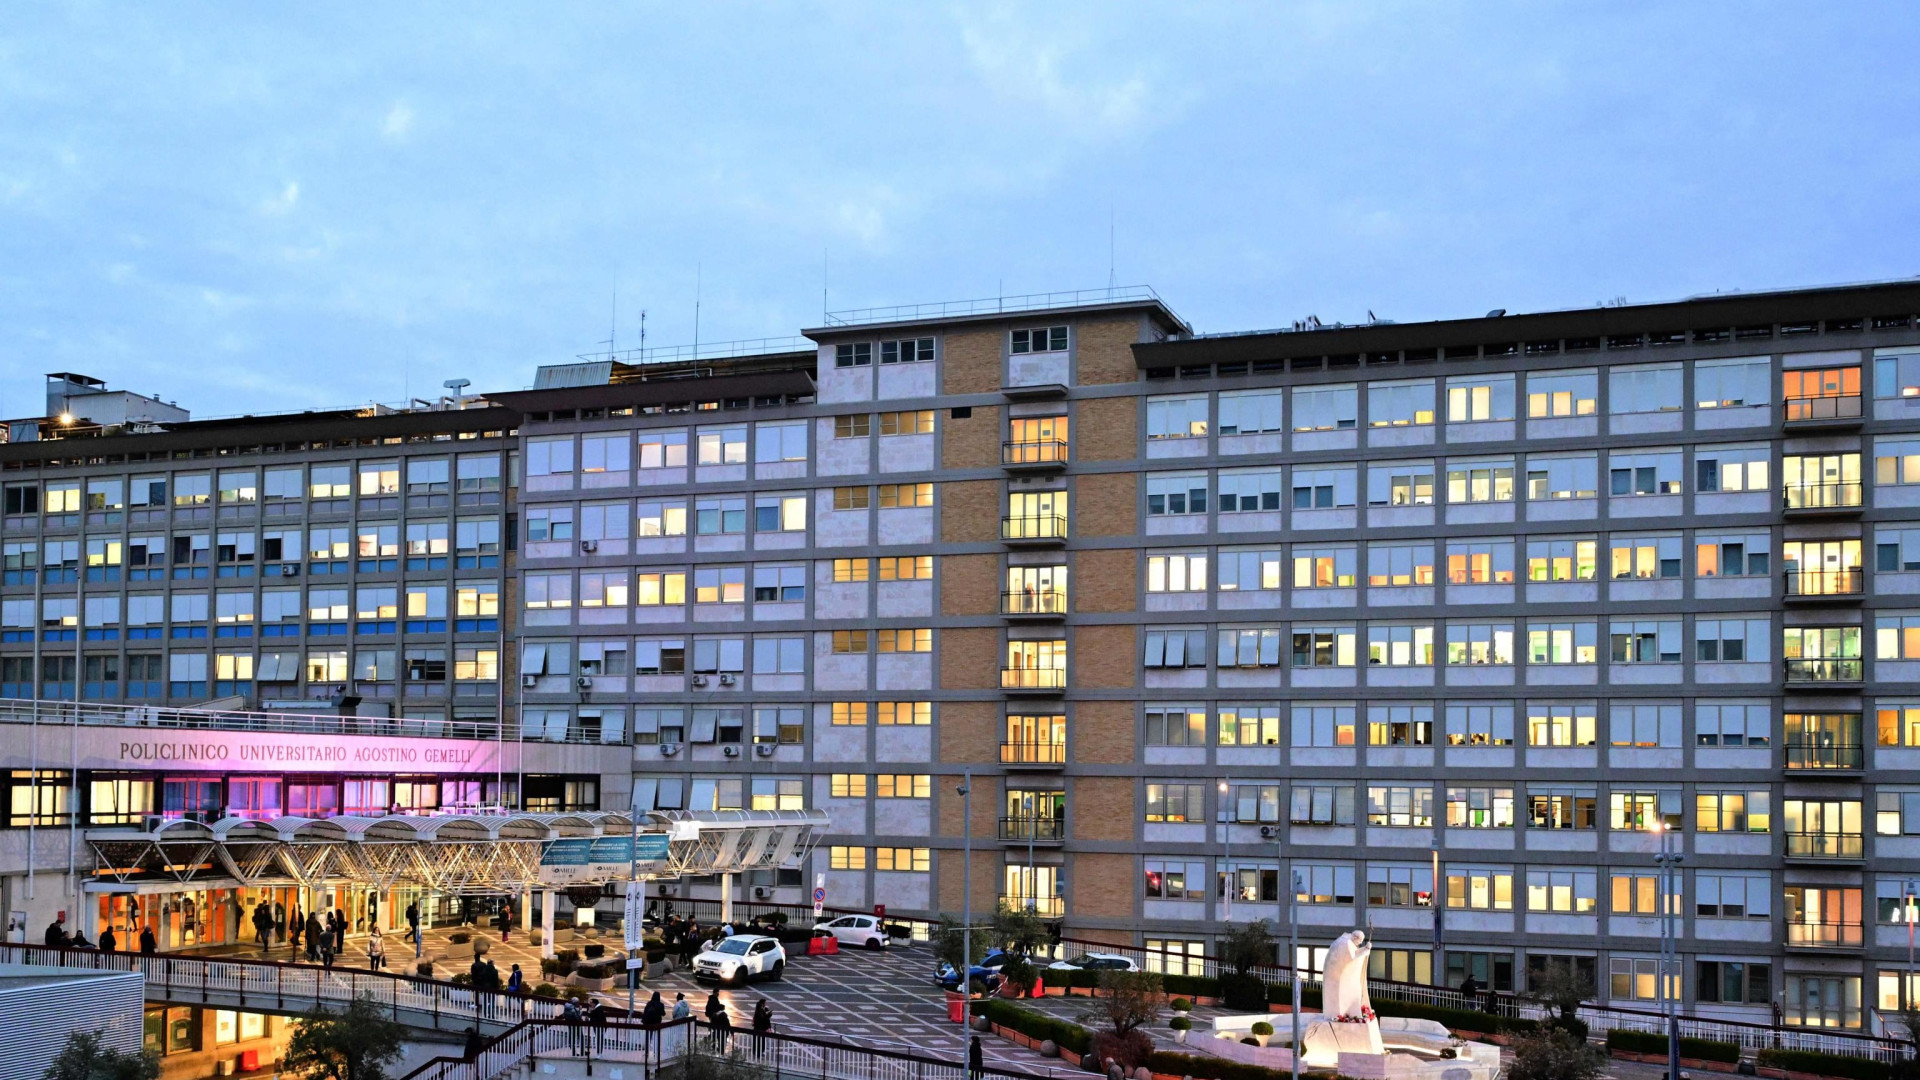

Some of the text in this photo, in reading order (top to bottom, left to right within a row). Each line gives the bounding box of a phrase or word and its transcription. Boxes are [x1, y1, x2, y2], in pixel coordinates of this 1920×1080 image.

[120, 742, 471, 764] POLICLINICO UNIVERSITARIO AGOSTINO GEMELLI
